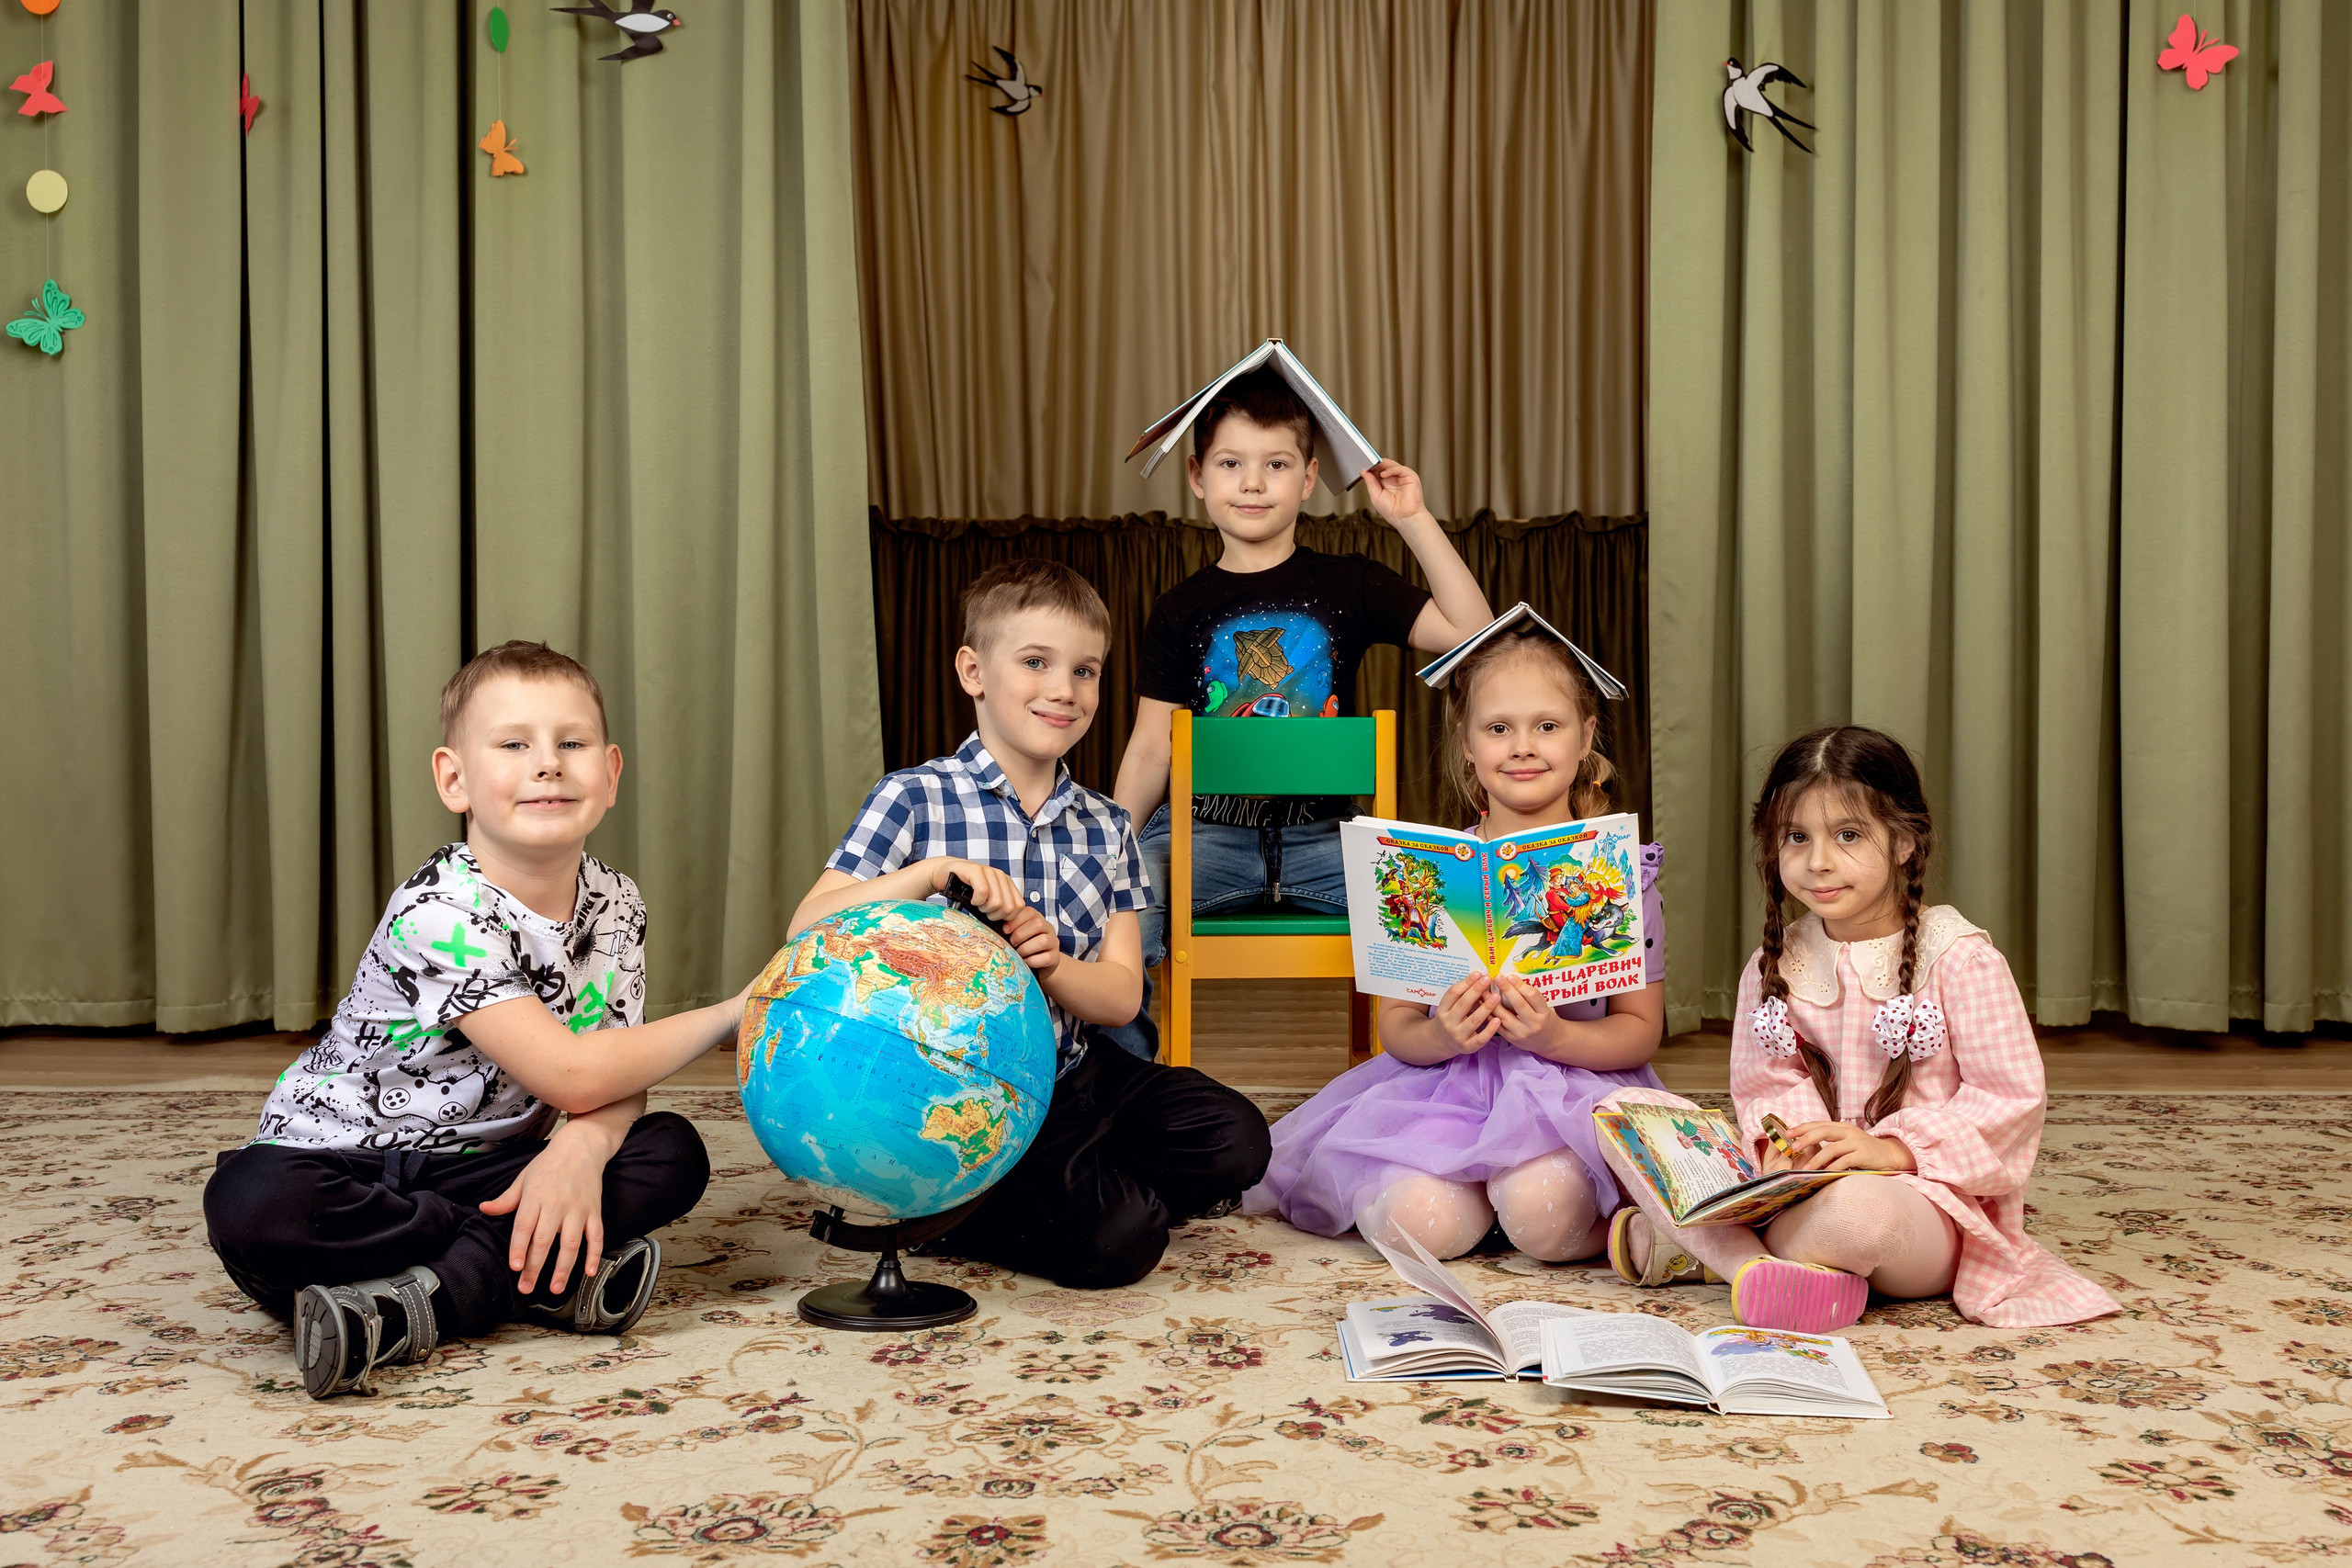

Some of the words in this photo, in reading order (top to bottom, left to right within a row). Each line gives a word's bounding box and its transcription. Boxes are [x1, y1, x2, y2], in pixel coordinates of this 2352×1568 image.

[1385, 838, 1411, 847] СКАЗКА
[1419, 842, 1449, 852] СКАЗКОЙ
[1521, 840, 1548, 851] СКАЗКА
[1557, 833, 1588, 844] СКАЗКОЙ
[1598, 833, 1632, 844] САМОВАР
[1482, 874, 1491, 900] СЕРЫЙ
[1485, 908, 1496, 965] ИВАН-ЦАРЕВИЧ
[1522, 956, 1642, 987] ВАН-ЦАРЕВИЧ
[1543, 979, 1589, 1002] ЕРЫЙ
[1594, 973, 1639, 992] ВОЛК
